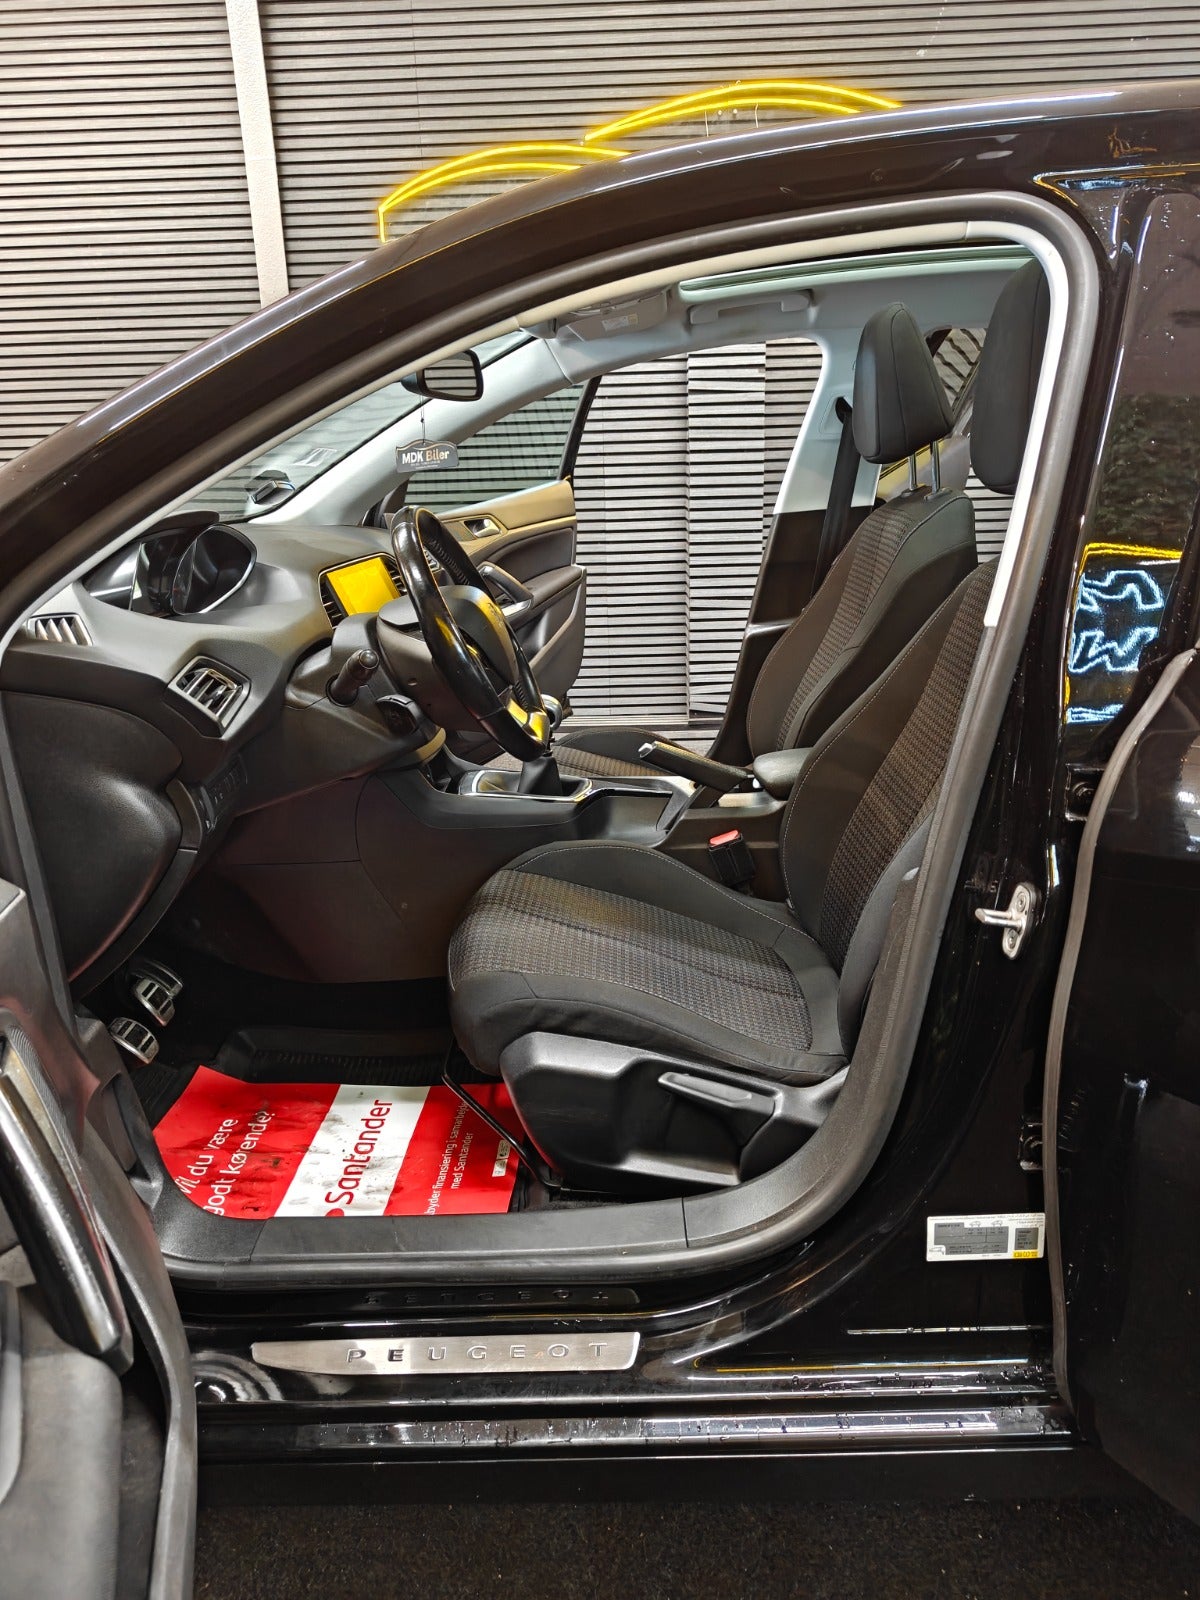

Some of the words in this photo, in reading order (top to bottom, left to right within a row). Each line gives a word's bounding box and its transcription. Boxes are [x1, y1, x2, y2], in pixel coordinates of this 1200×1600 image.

[402, 451, 424, 464] MDK
[426, 449, 449, 461] Biler
[187, 1154, 214, 1176] du
[203, 1119, 239, 1150] være
[324, 1099, 393, 1205] Santander
[432, 1144, 458, 1189] finansiering
[453, 1133, 474, 1171] Santander
[203, 1178, 236, 1216] godt
[451, 1172, 463, 1189] med
[347, 1343, 607, 1363] PEUGEOT
